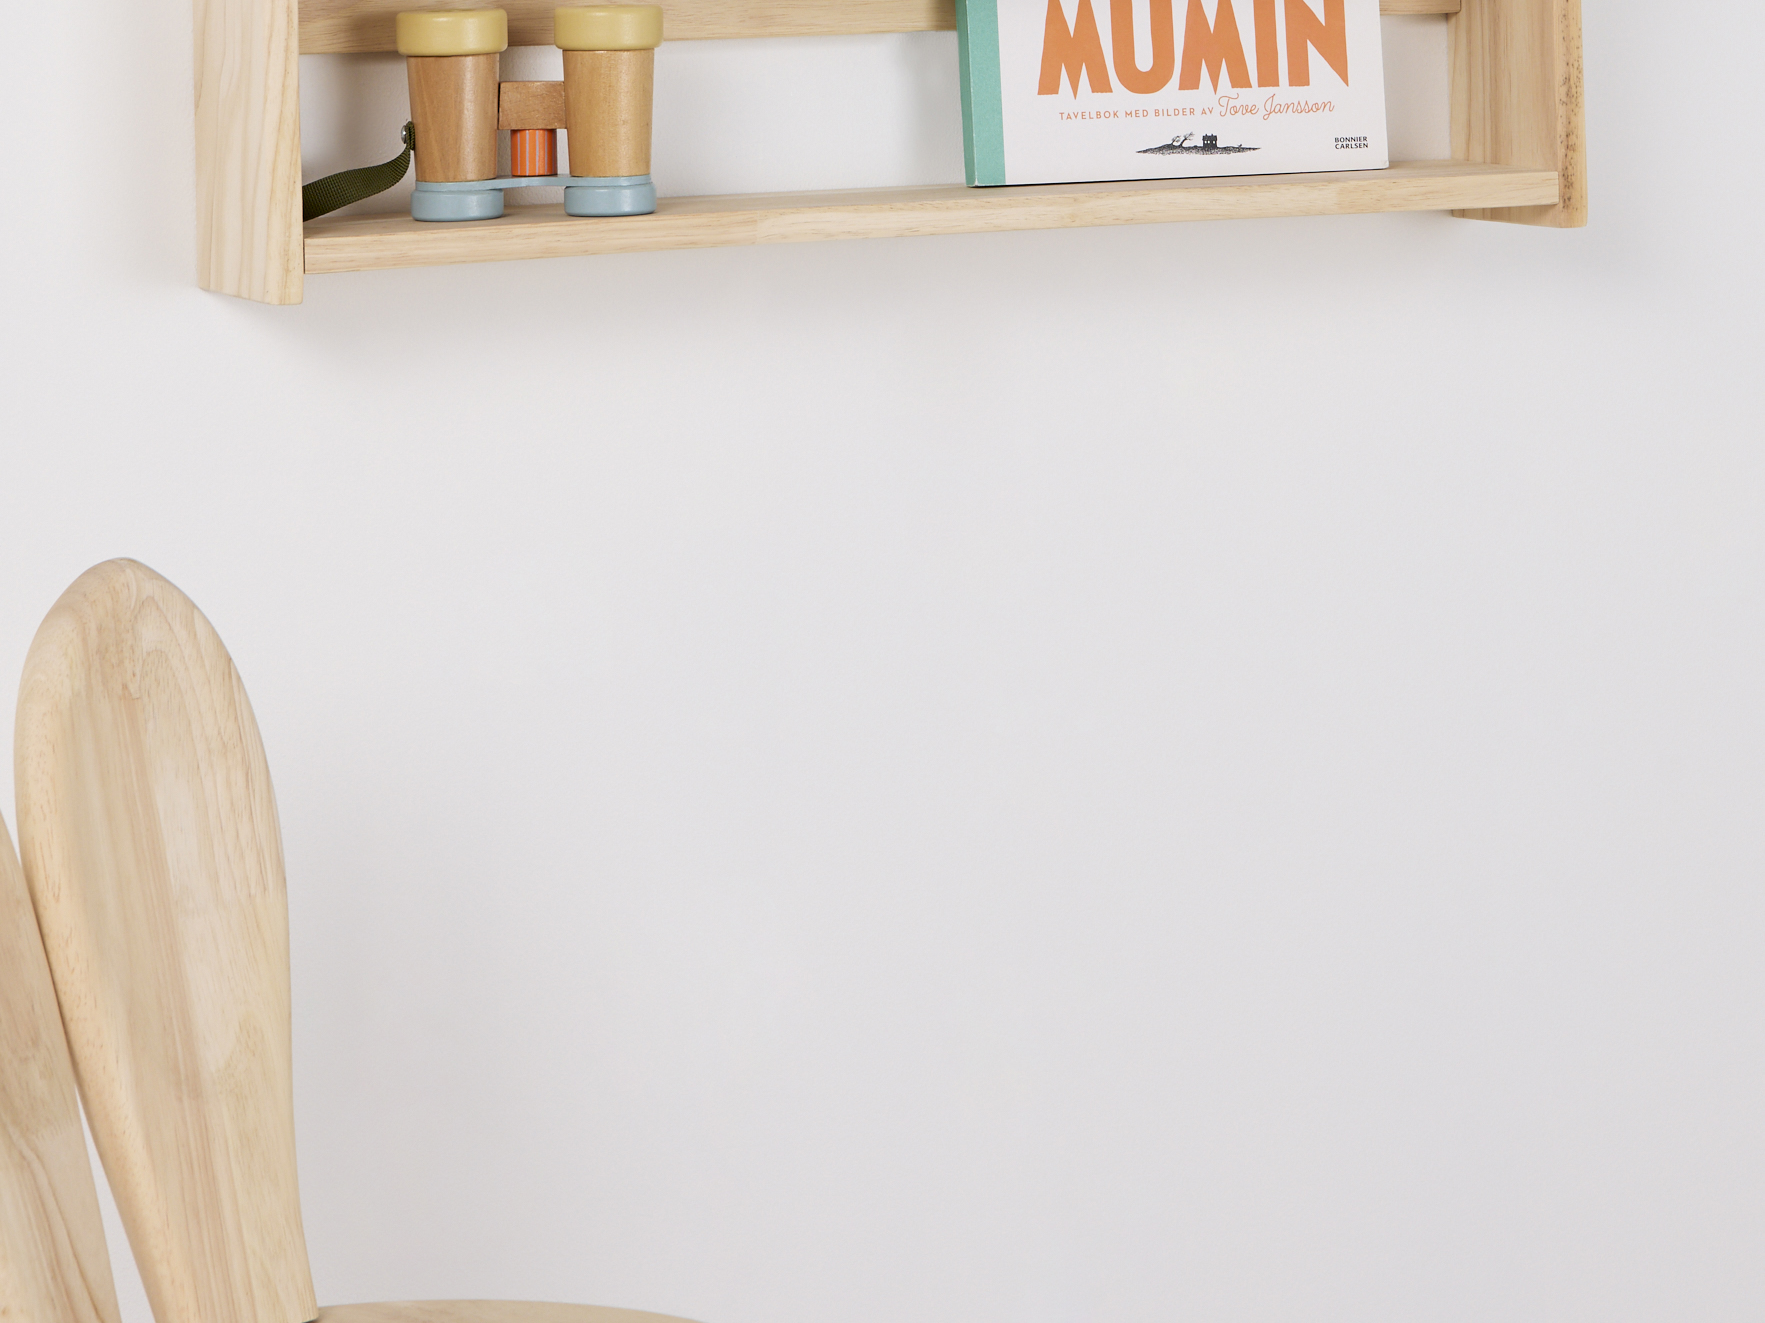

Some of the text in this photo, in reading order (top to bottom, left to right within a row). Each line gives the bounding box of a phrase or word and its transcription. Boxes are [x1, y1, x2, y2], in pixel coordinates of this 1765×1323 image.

[1059, 92, 1336, 121] TAVELBOK MED BILDER AV Tove Jansson
[1334, 142, 1369, 150] CARLSEN
